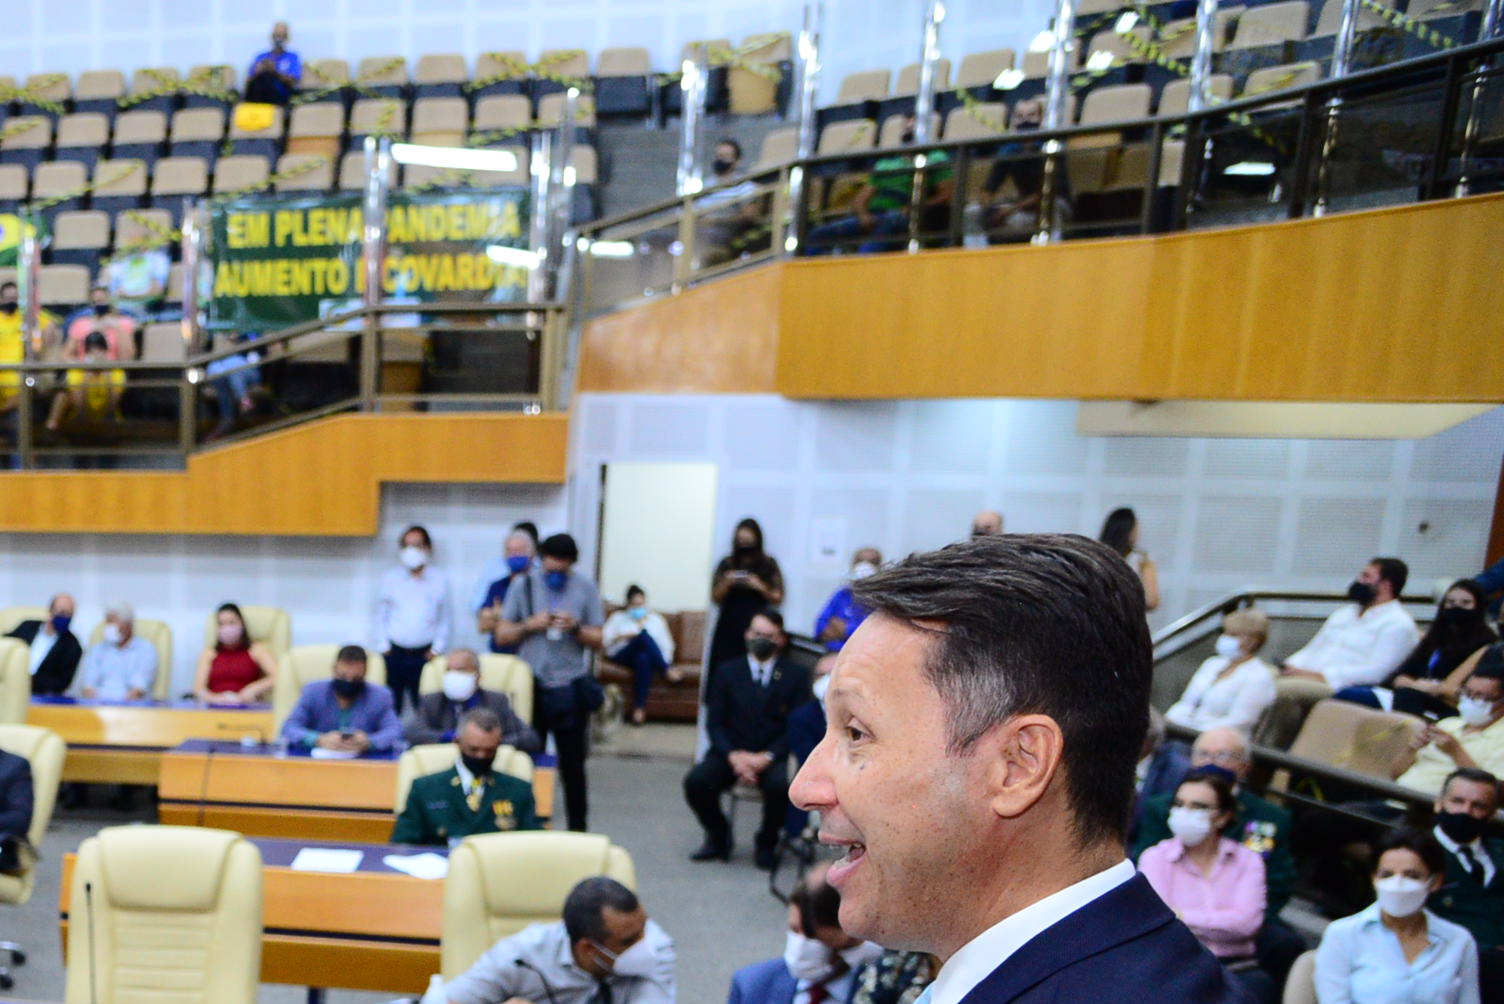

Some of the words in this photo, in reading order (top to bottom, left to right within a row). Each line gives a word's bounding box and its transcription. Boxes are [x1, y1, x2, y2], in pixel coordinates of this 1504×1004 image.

[227, 211, 271, 249] EM
[274, 206, 364, 247] PLENA
[380, 202, 521, 244] ANDEMA
[214, 256, 350, 298] AUMENTO
